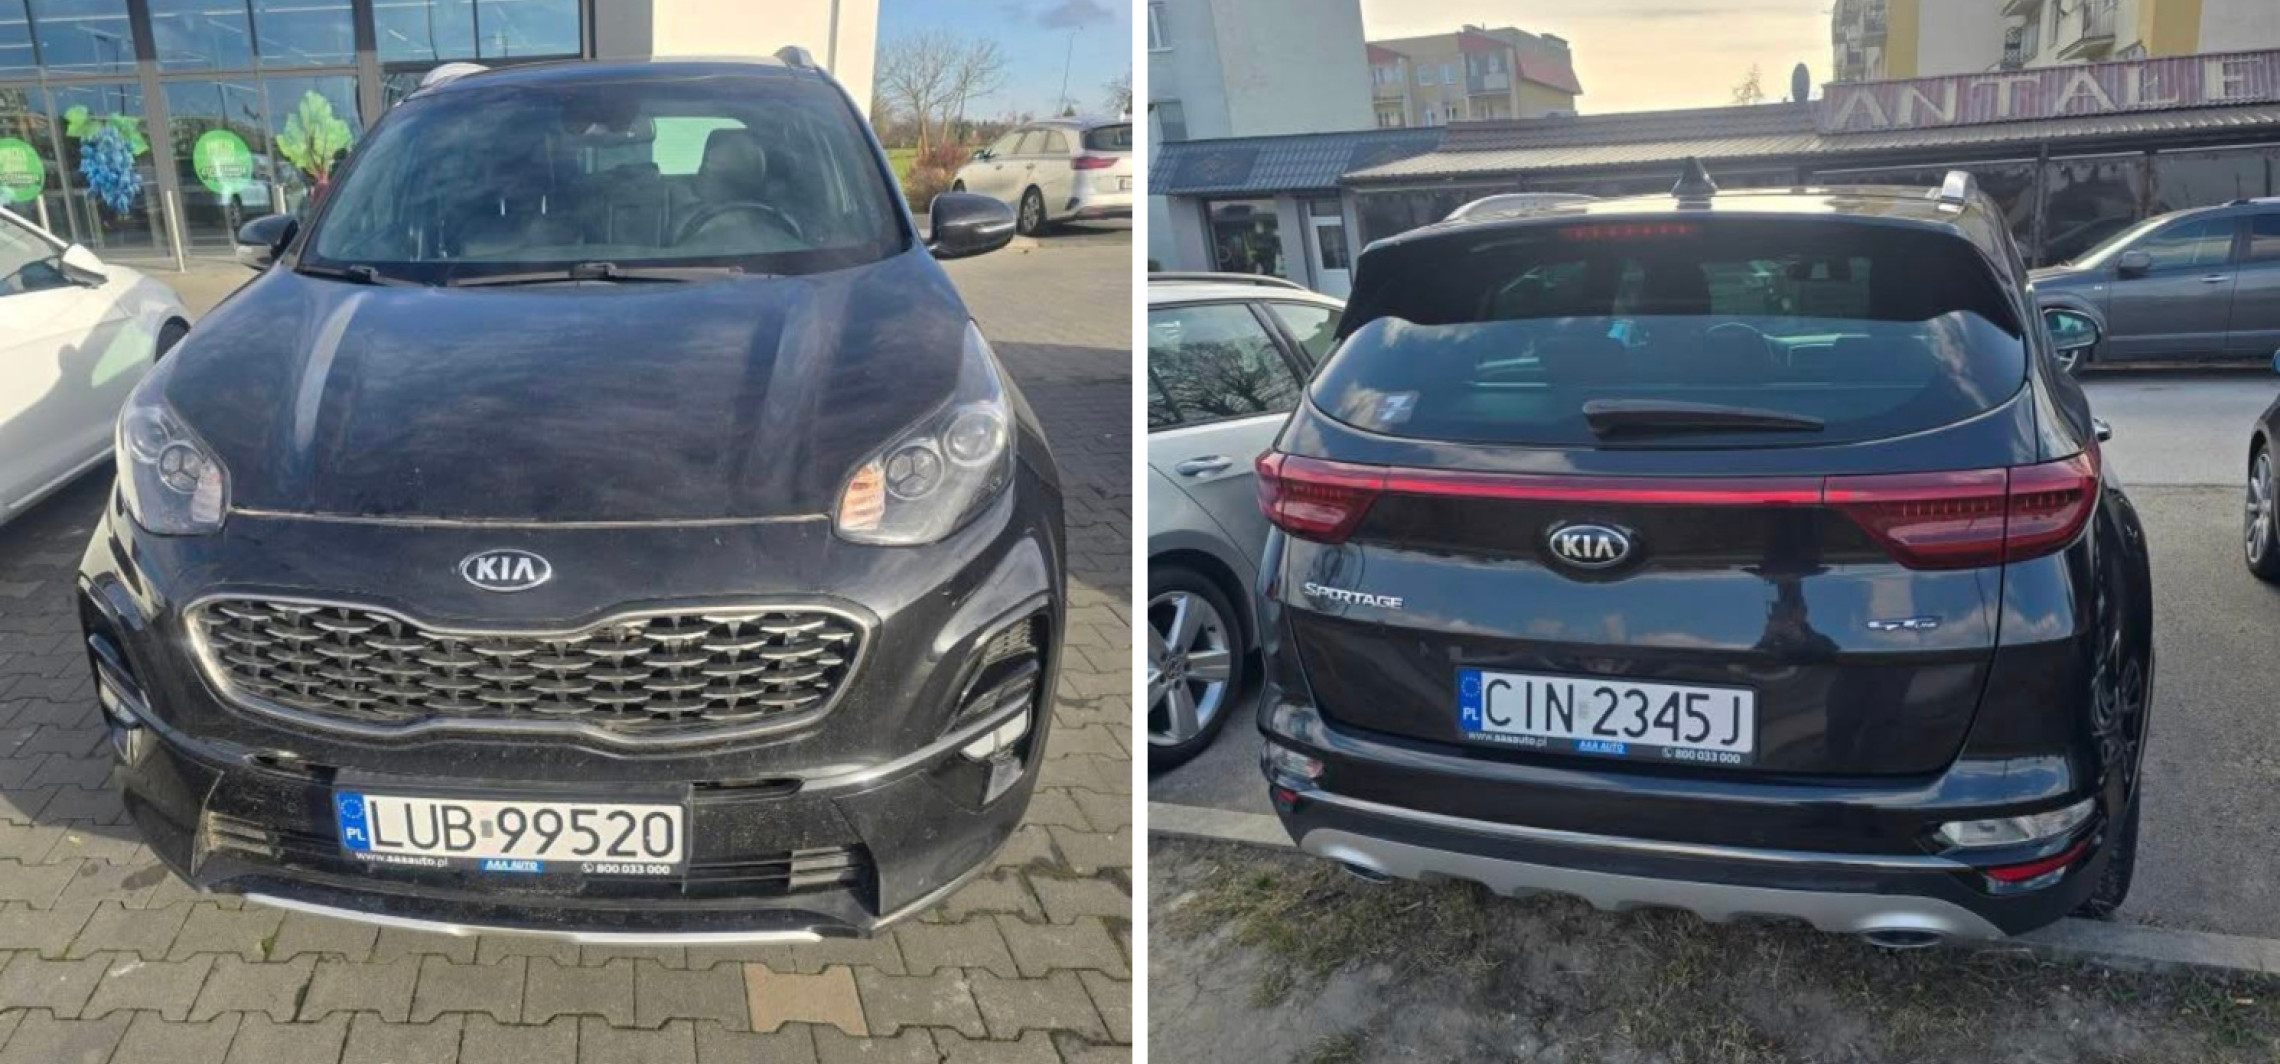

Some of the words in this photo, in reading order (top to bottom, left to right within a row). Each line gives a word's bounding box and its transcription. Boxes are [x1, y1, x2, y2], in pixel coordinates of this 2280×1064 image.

[1561, 534, 1615, 559] KIA
[476, 556, 535, 581] KIA
[1304, 581, 1404, 609] SPORTAGE
[1462, 707, 1480, 721] PL
[1486, 678, 1574, 733] CIN
[1592, 686, 1741, 746] 2345J
[1468, 732, 1548, 747] www.aaaauto.pl
[1578, 741, 1599, 752] AAA
[1600, 743, 1625, 754] AUTO
[1674, 748, 1696, 761] 800
[1697, 750, 1718, 762] 033
[1719, 753, 1741, 764] 000
[345, 826, 367, 842] PL
[370, 800, 476, 852] LUB
[496, 807, 675, 858] 99520
[355, 851, 449, 868] www.aaaauto.pl
[484, 860, 508, 871] AAA
[509, 861, 538, 872] AUTO
[596, 863, 620, 875] 800
[621, 864, 645, 875] 033
[646, 865, 671, 876] 000
